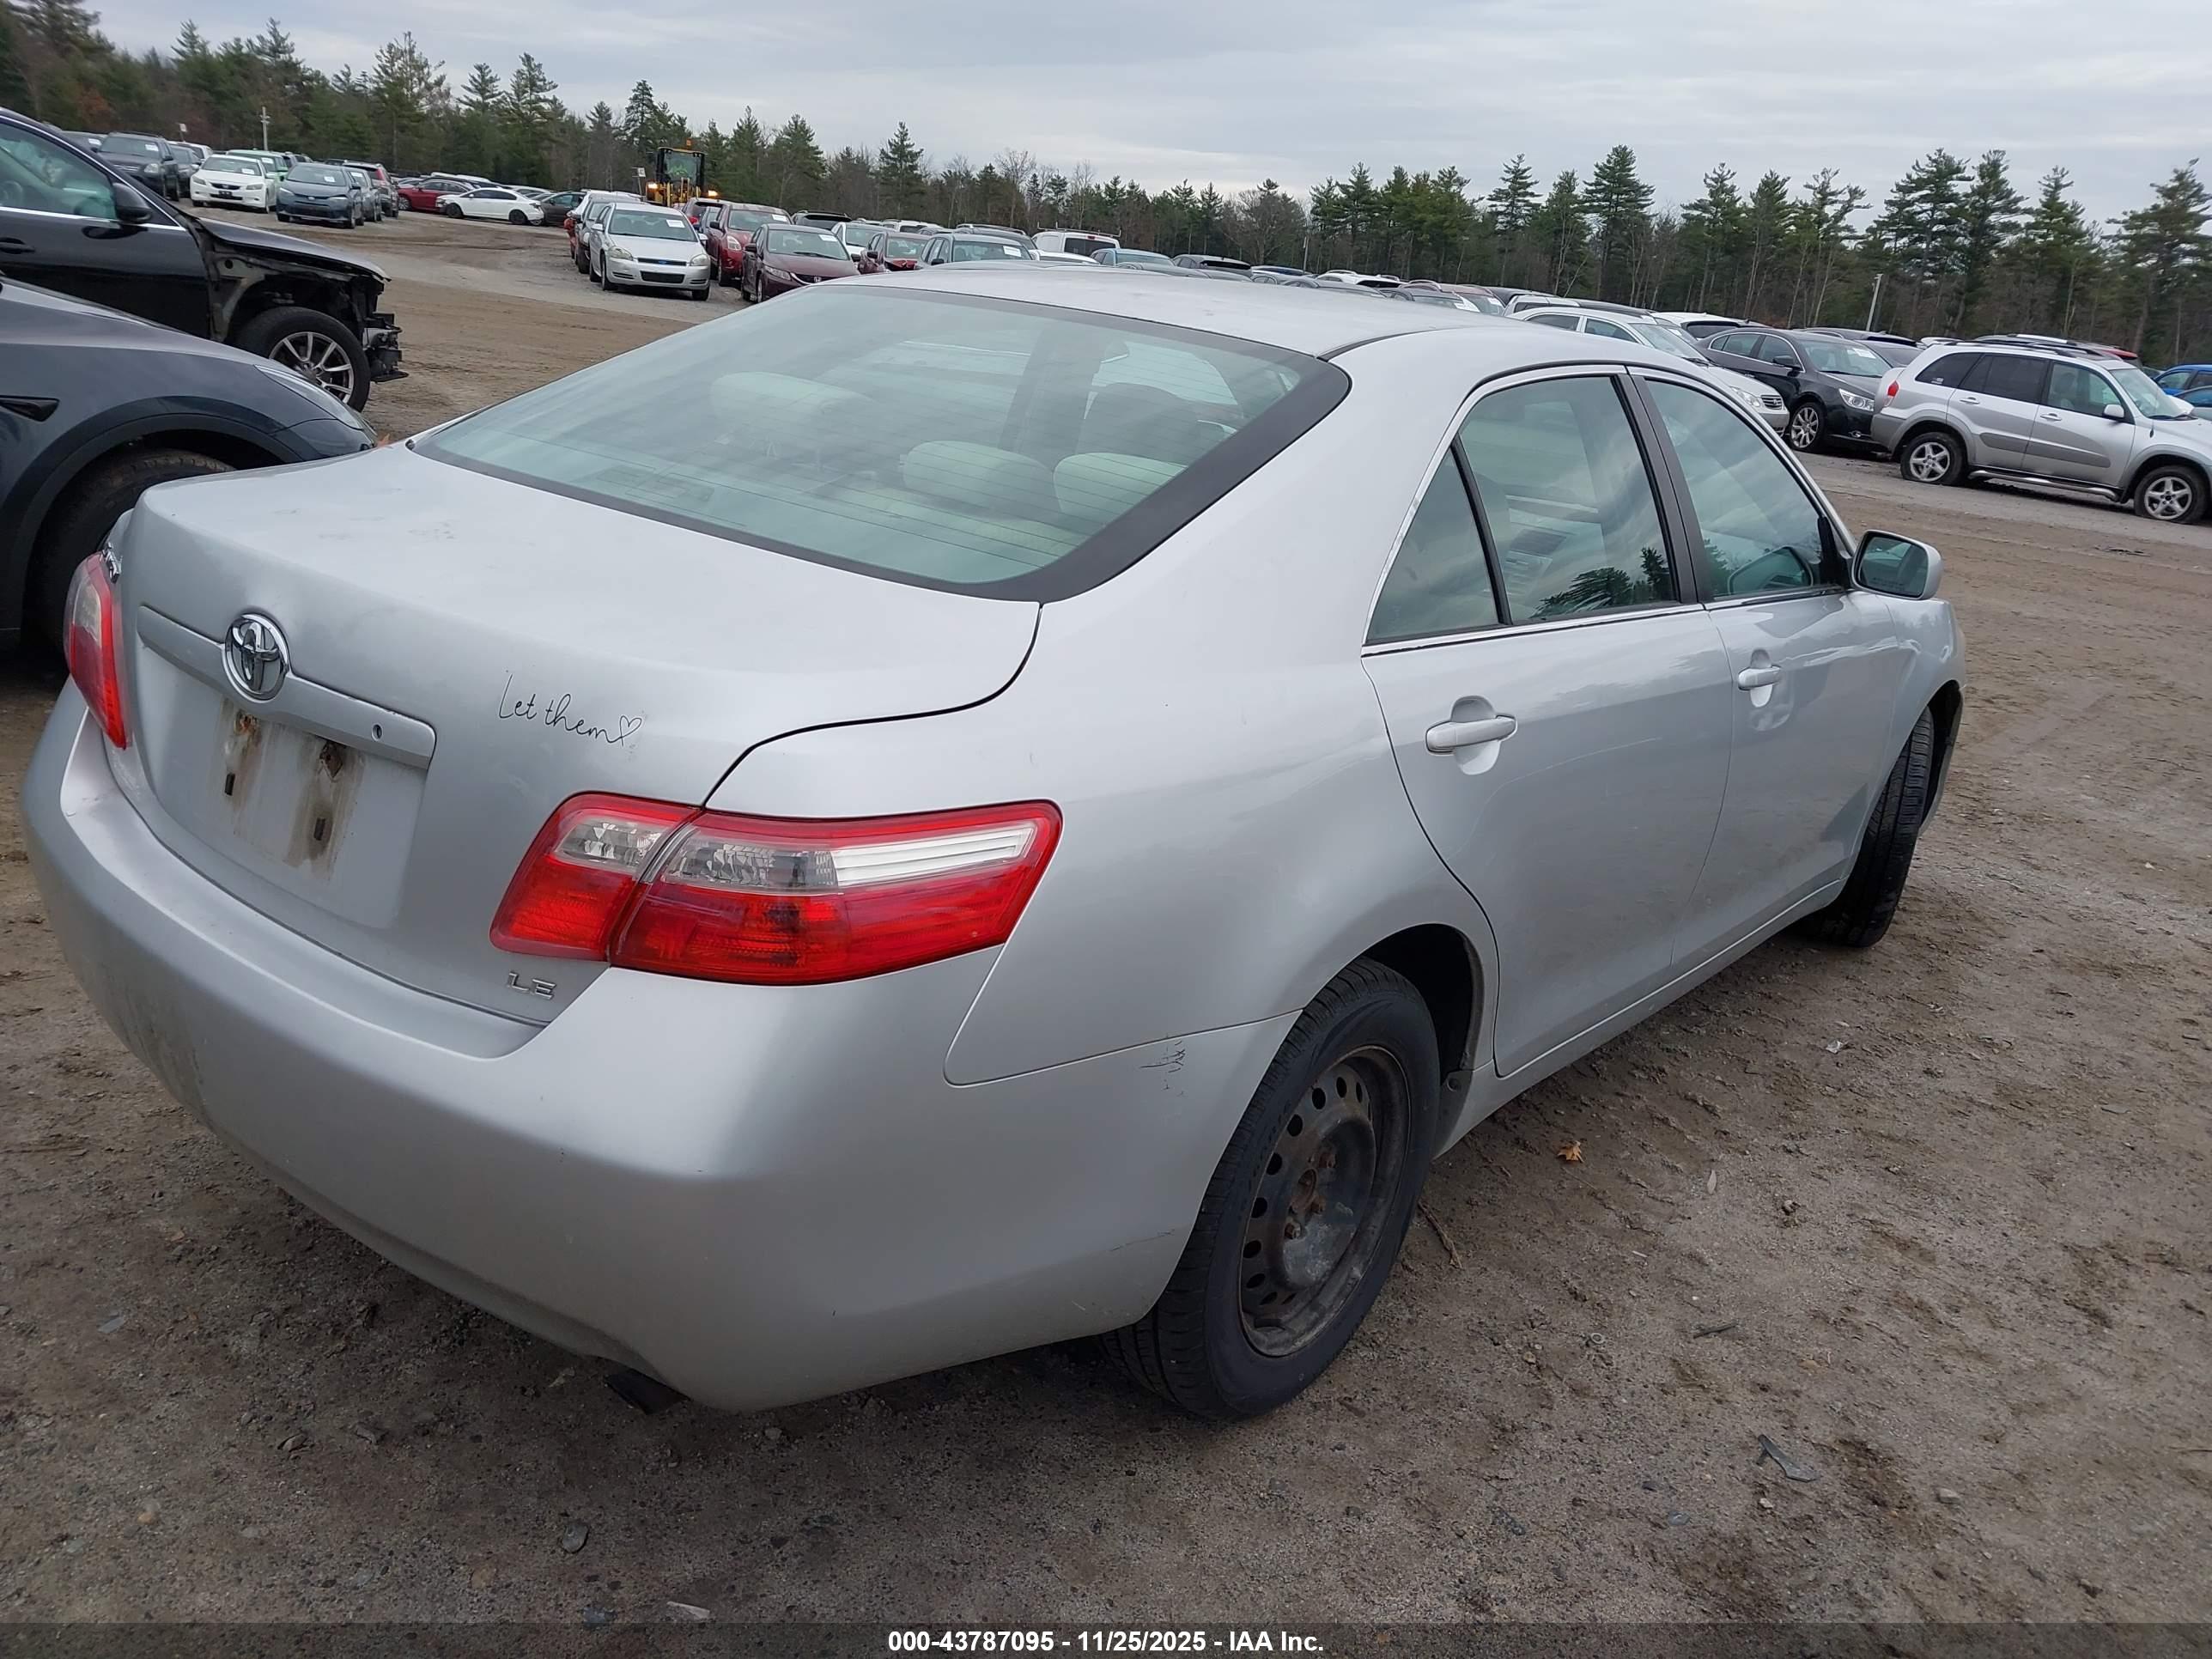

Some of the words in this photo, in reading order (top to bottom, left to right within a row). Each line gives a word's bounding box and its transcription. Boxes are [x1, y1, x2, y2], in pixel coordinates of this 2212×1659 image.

[499, 674, 538, 720] Let
[544, 693, 622, 744] them
[507, 971, 556, 1000] LE
